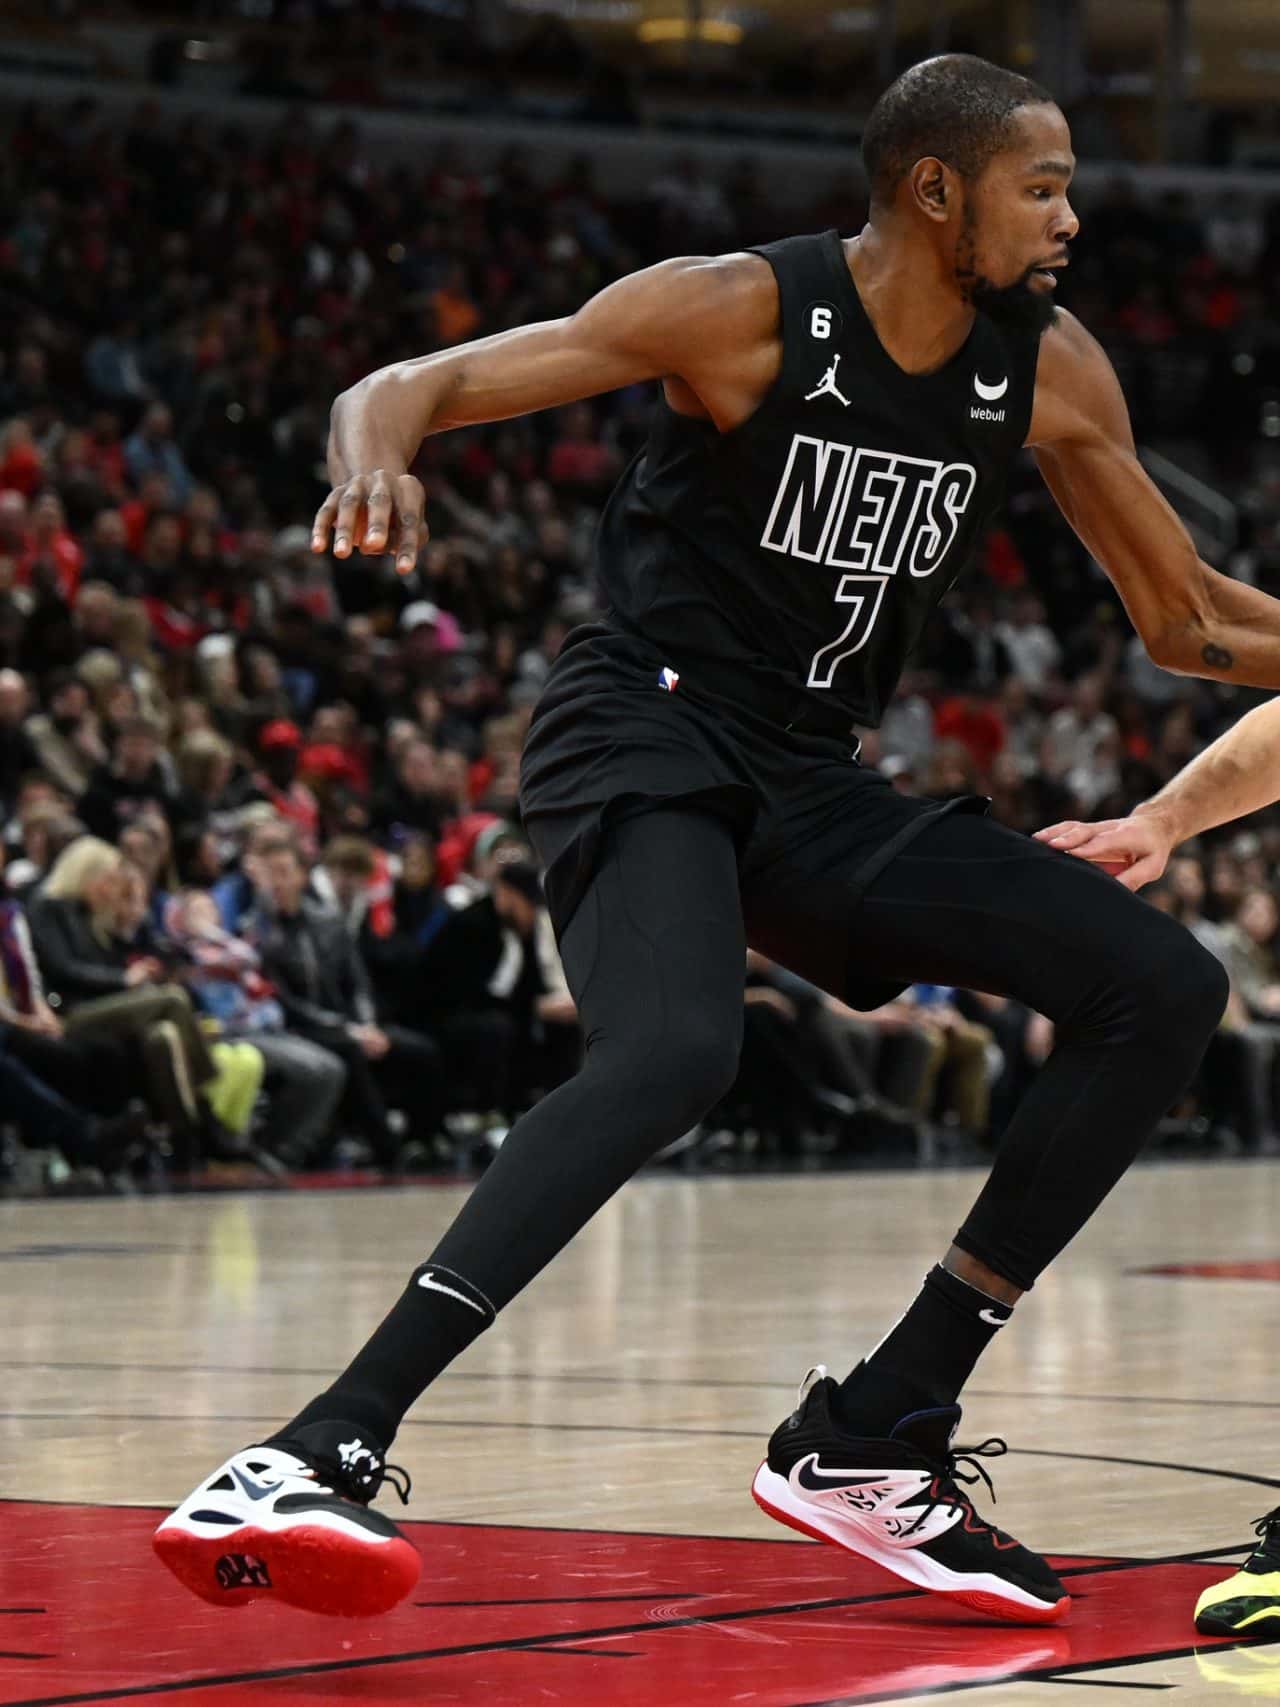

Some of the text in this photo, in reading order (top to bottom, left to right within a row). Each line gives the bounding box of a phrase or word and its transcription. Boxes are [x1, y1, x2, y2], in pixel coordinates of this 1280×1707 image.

[811, 308, 832, 339] 6
[970, 406, 1006, 422] Webull
[760, 433, 977, 577] NETS
[806, 575, 890, 688] 7
